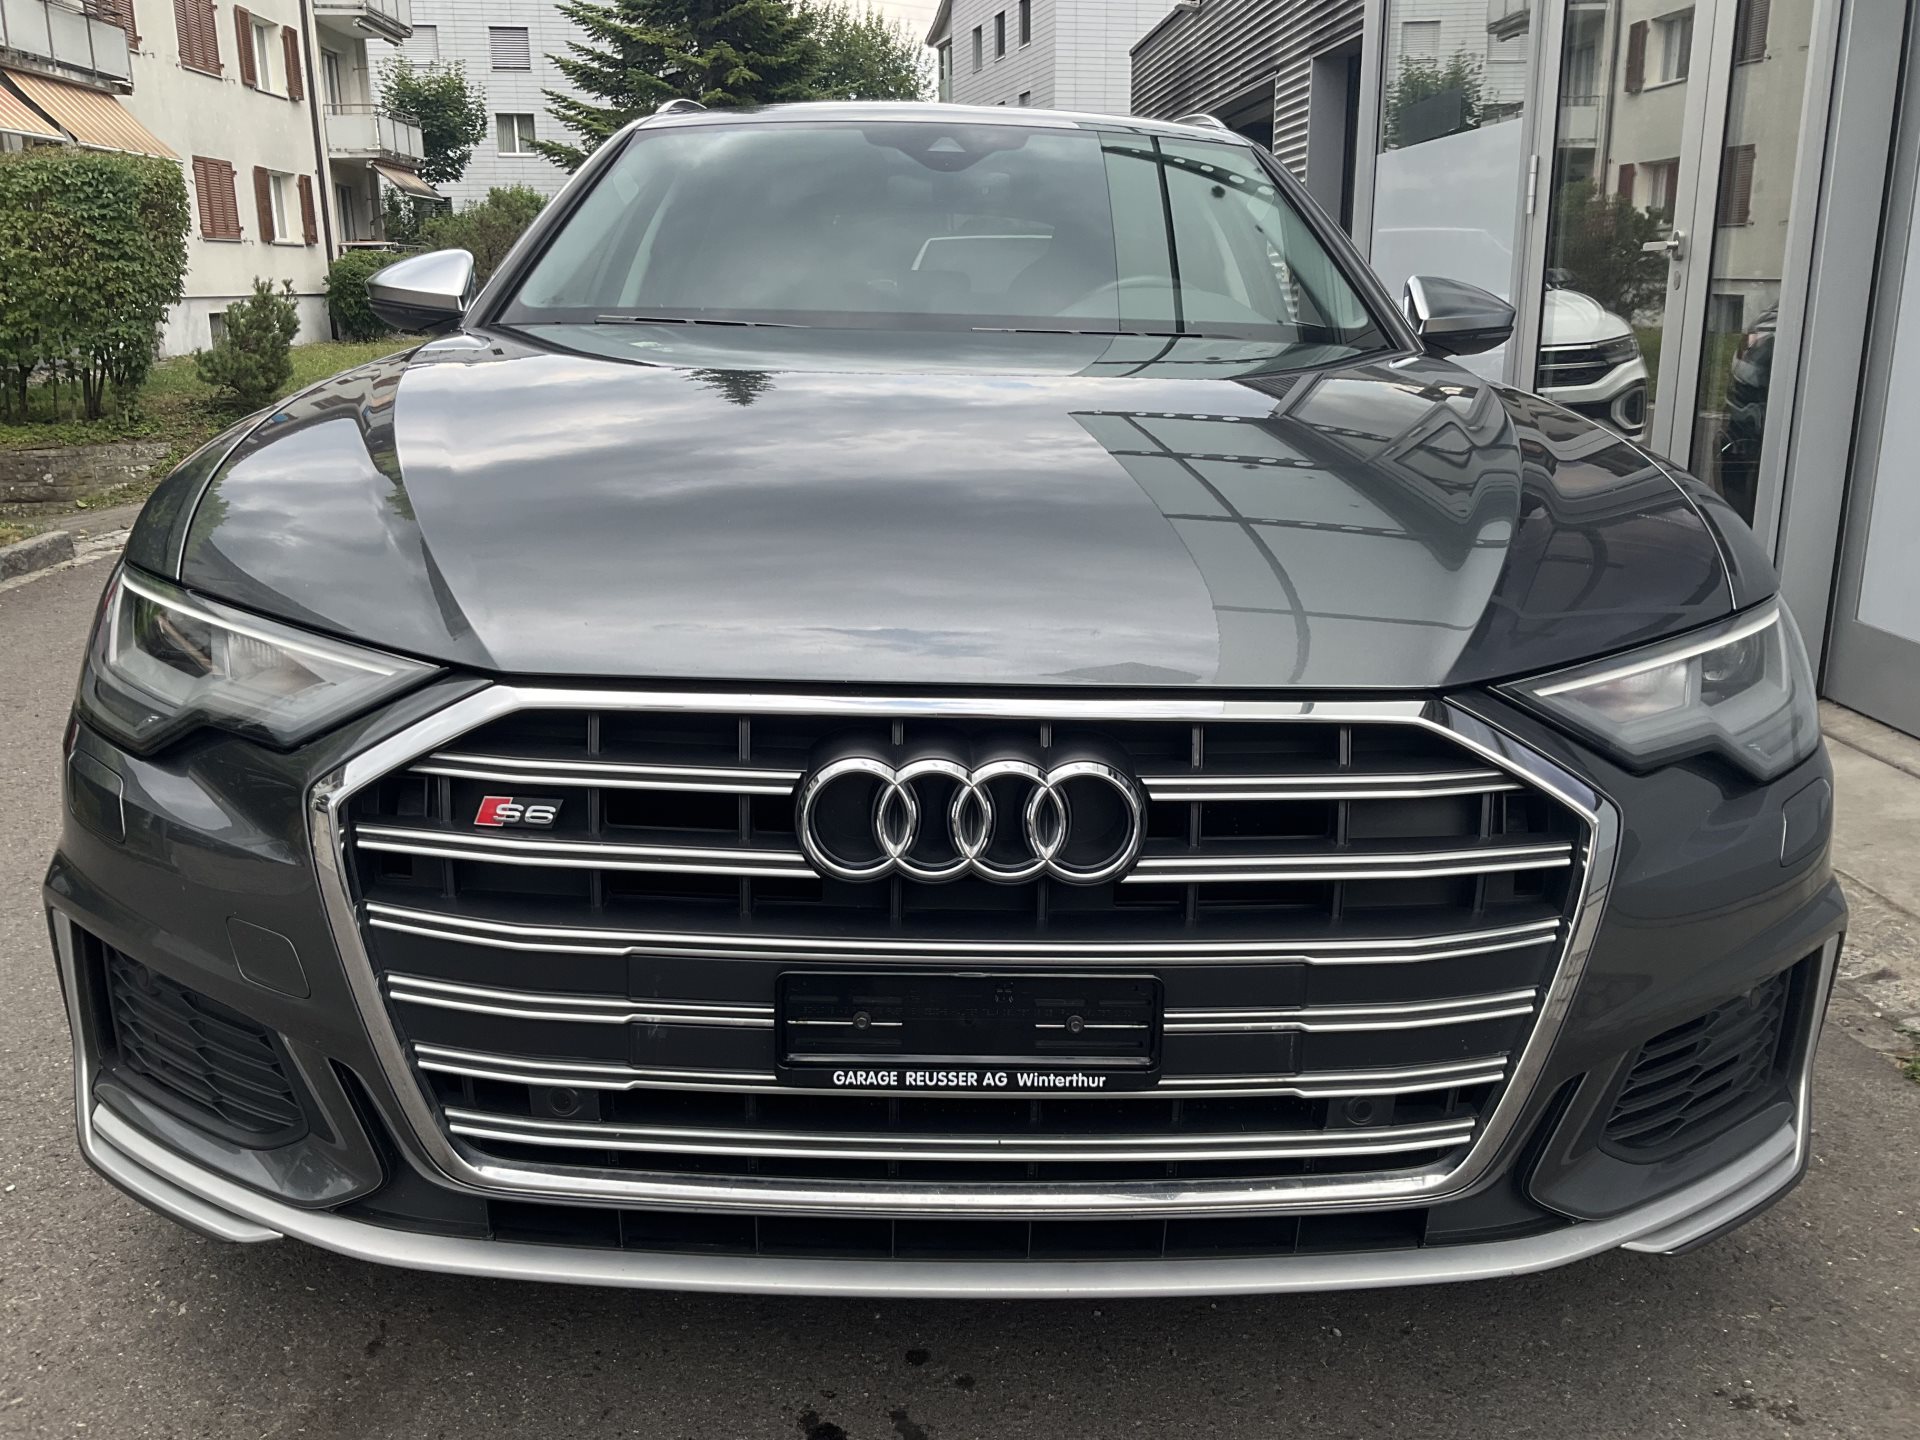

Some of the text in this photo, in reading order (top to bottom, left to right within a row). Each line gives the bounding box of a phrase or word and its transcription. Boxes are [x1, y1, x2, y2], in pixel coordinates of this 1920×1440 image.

[492, 803, 557, 825] S6
[832, 1070, 1107, 1088] GARAGE REUSSER AG Winterthur
